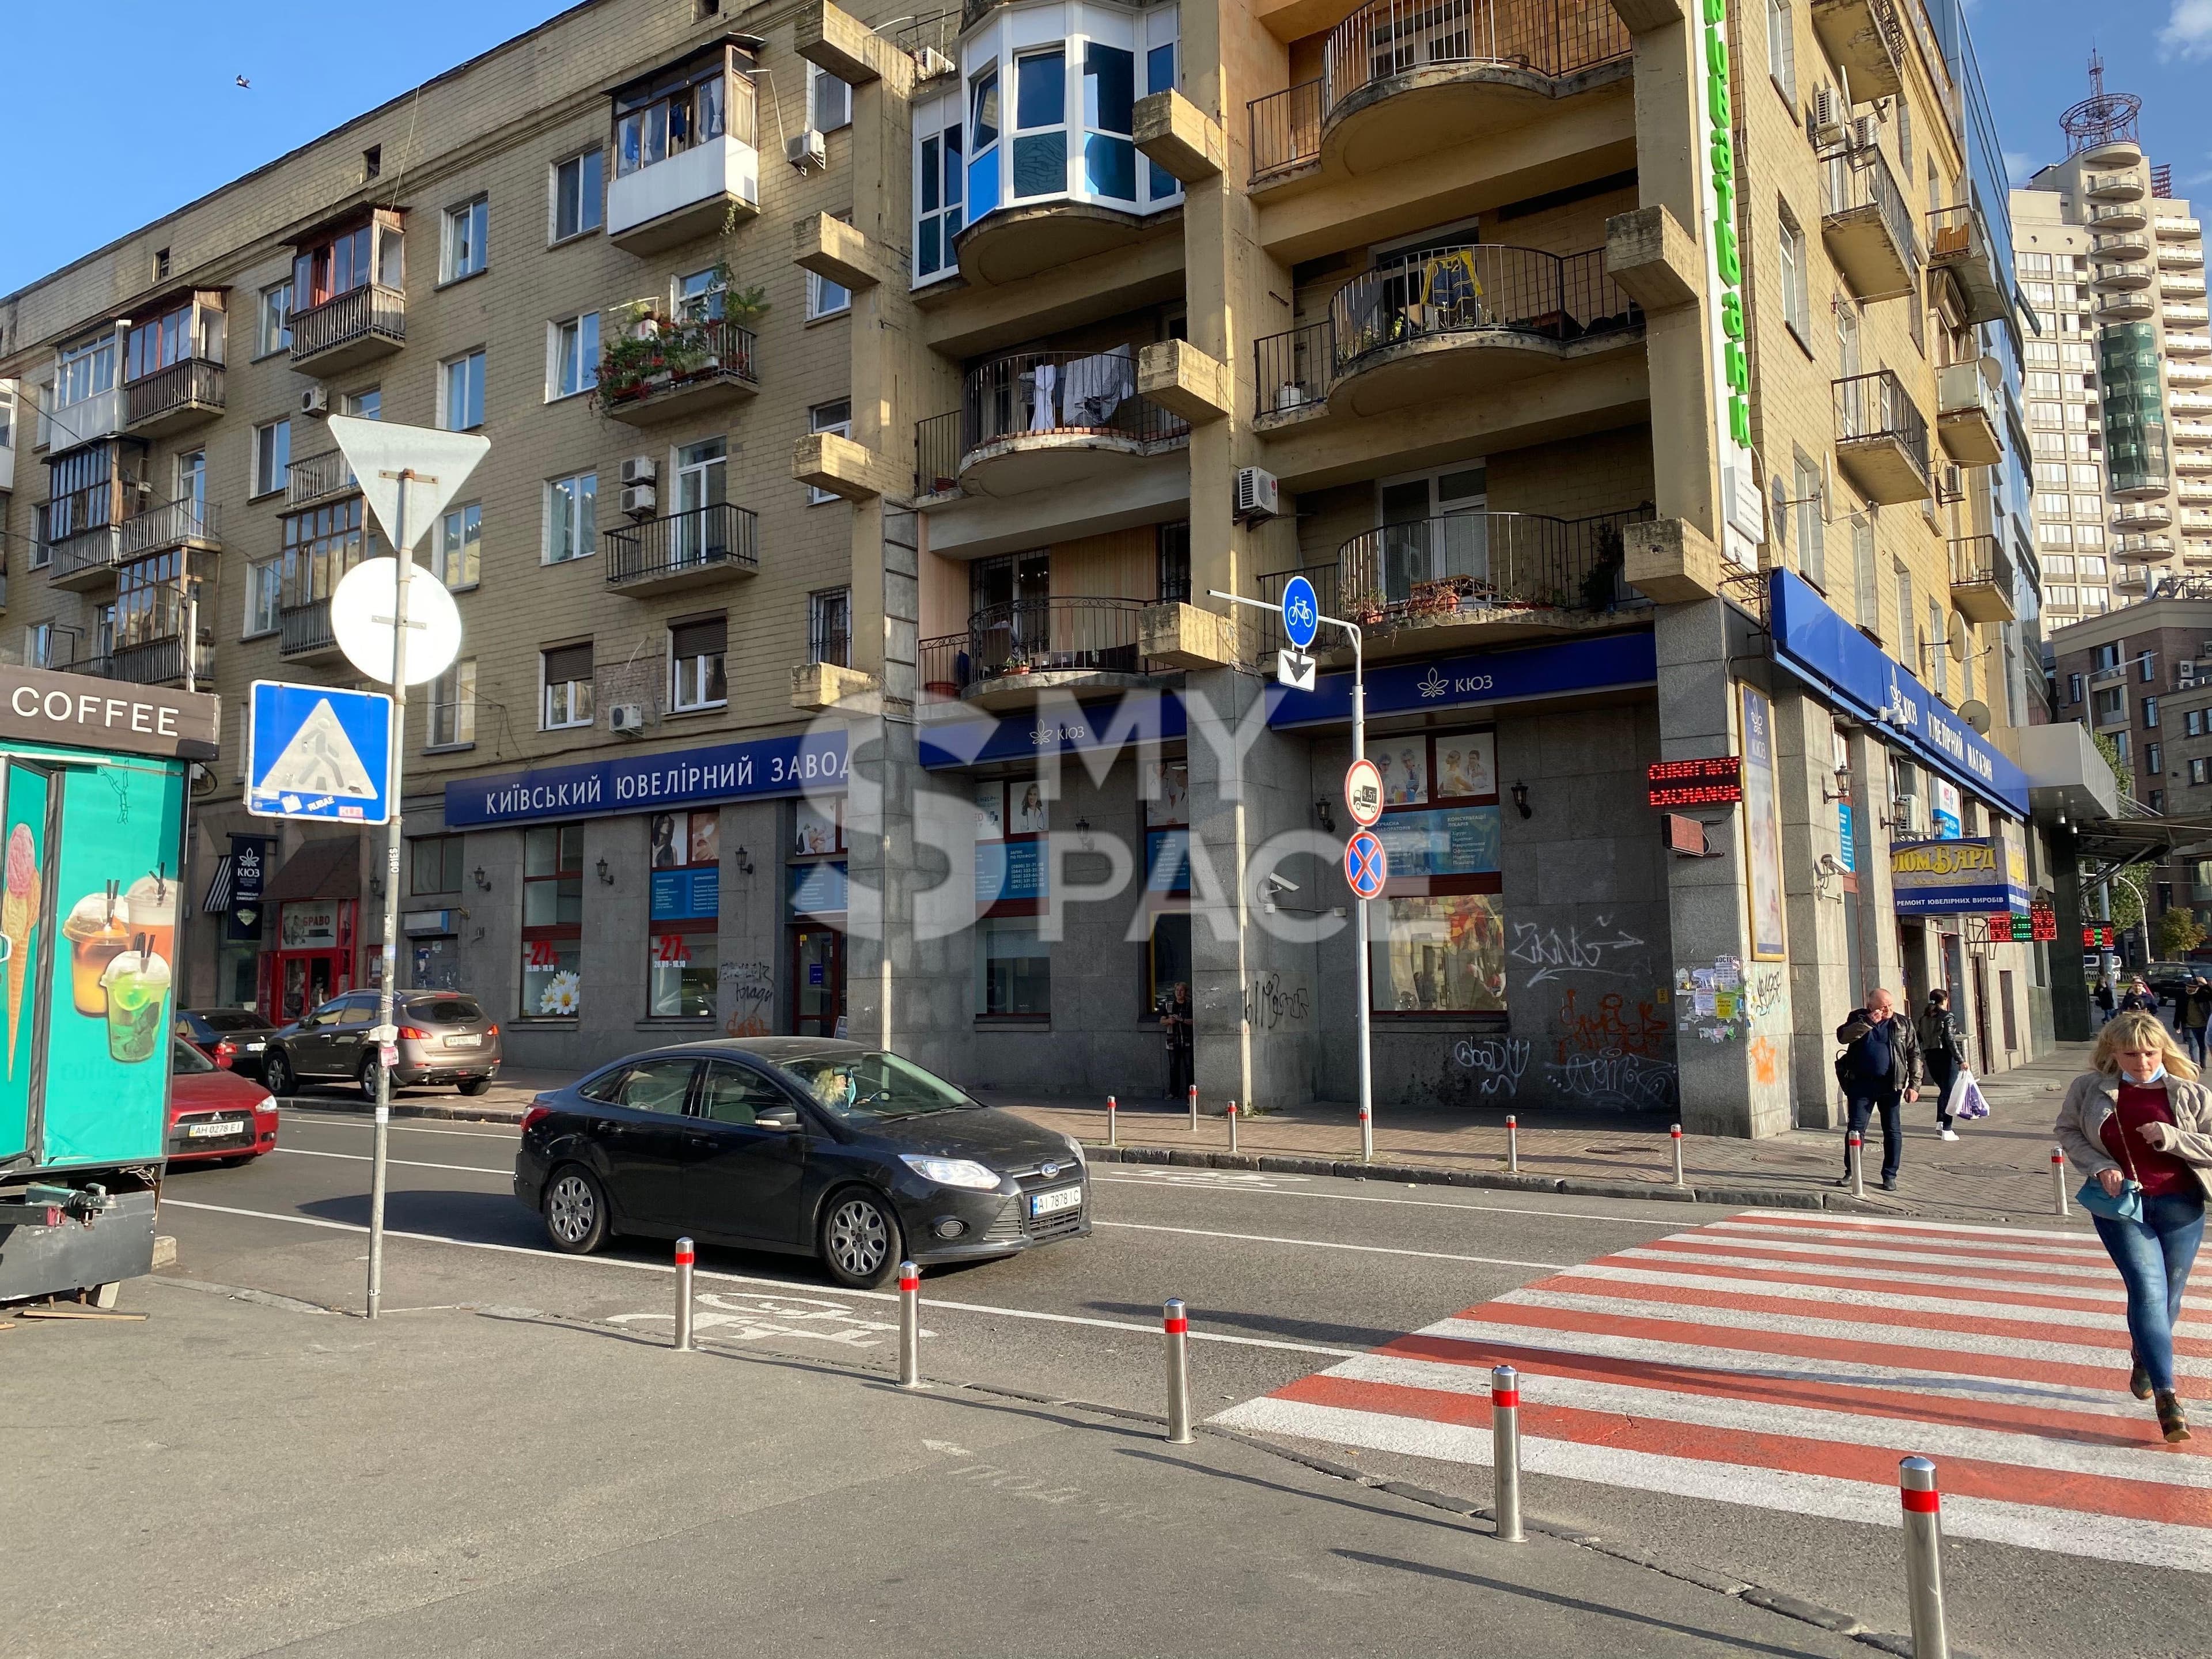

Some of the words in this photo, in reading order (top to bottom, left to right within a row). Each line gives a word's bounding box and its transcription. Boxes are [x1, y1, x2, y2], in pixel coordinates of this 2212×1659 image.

[1456, 675, 1493, 692] КЮЗ
[12, 686, 179, 737] COFFEE
[1057, 726, 1084, 740] КЮЗ
[1903, 696, 1918, 726] КЮЗ
[1927, 710, 1964, 762] ЮВЕЛІРНИЙ
[1967, 743, 1993, 782] МАГАЗИН
[1649, 758, 1740, 779] CURRENCY
[487, 774, 600, 815] КИЇВСЬКИЙ
[617, 755, 752, 800] ЮВЕЛІРНИЙ
[1650, 785, 1741, 805] EXCHANGE
[237, 868, 260, 877] КЮЗ
[303, 915, 330, 926] БРАВО
[1050, 1192, 1068, 1208] 7878
